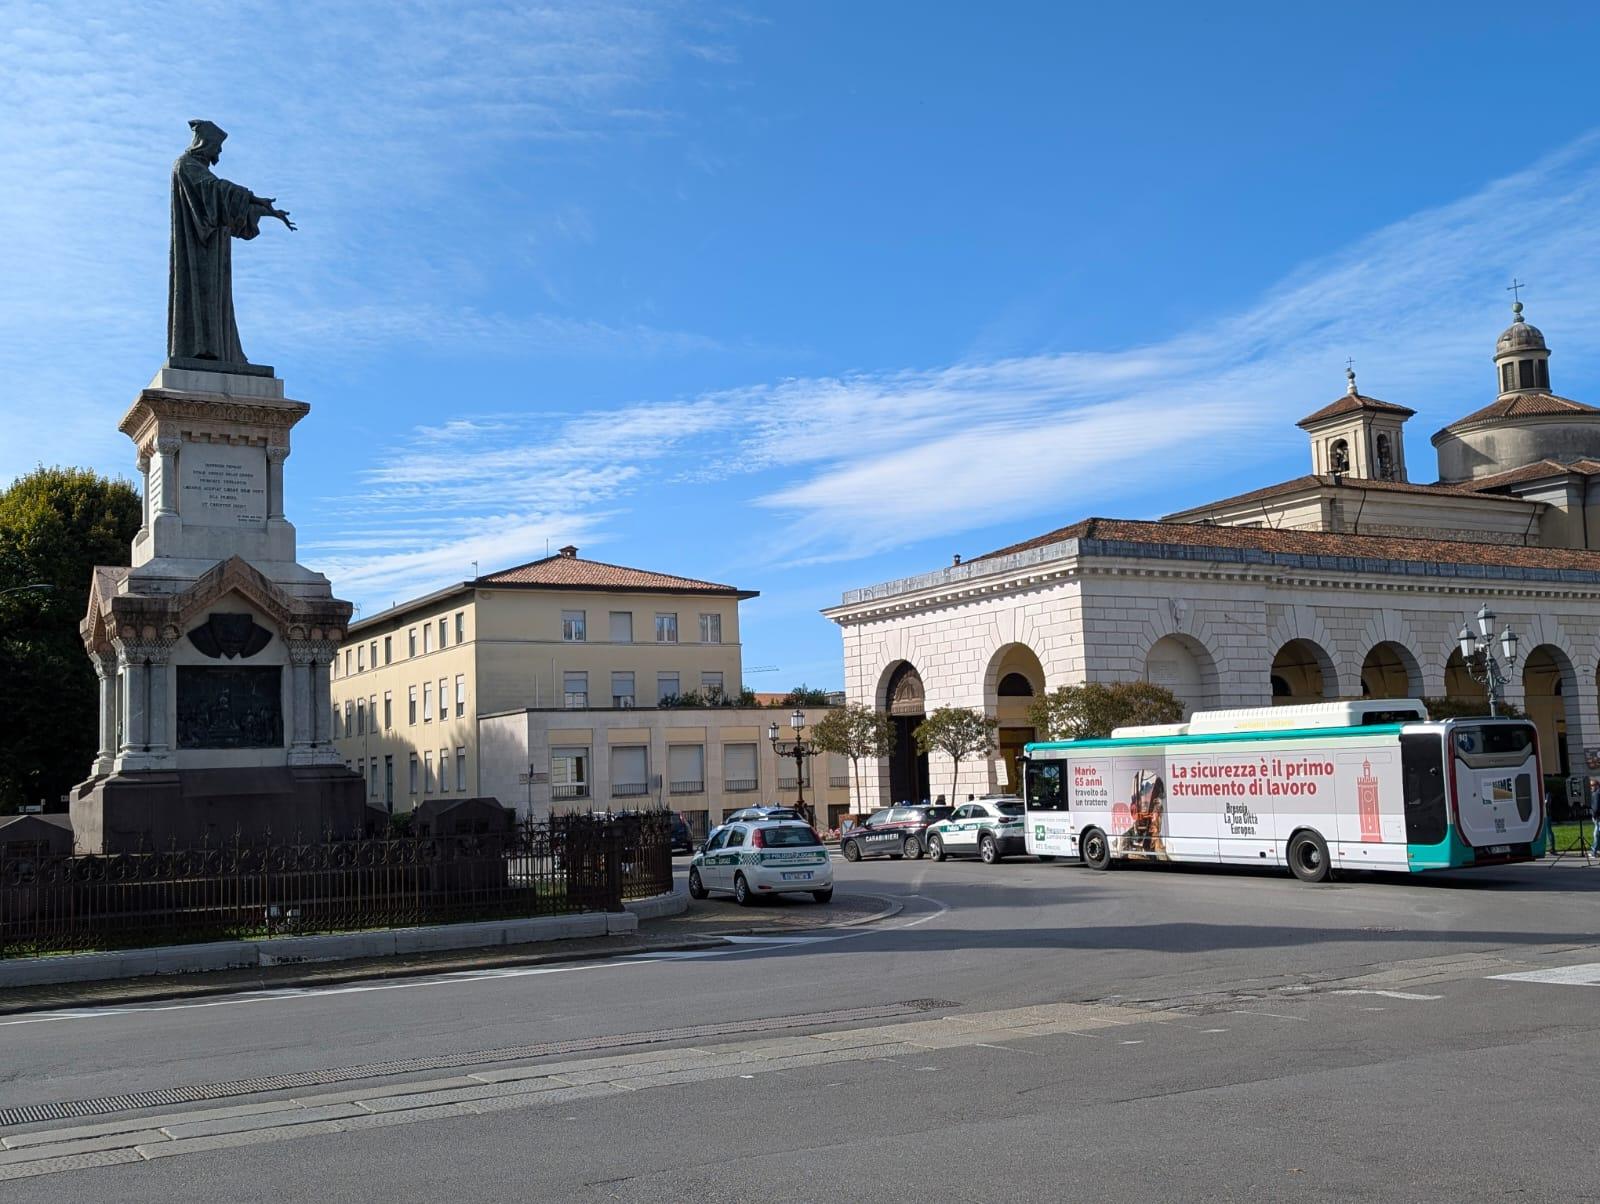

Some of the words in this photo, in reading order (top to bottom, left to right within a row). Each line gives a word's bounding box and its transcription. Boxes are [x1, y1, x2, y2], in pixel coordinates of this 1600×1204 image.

[1074, 766, 1097, 776] Mario
[1172, 764, 1187, 778] La
[1191, 761, 1256, 778] sicurezza
[1260, 758, 1268, 776] è
[1272, 759, 1282, 777] il
[1286, 758, 1334, 780] primo
[1075, 777, 1085, 786] 65
[1085, 776, 1103, 786] anni
[1075, 788, 1099, 796] travolto
[1100, 788, 1108, 796] da
[1172, 781, 1246, 796] strumento
[1249, 779, 1263, 796] di
[1267, 779, 1317, 796] lavoro
[1224, 814, 1231, 824] La
